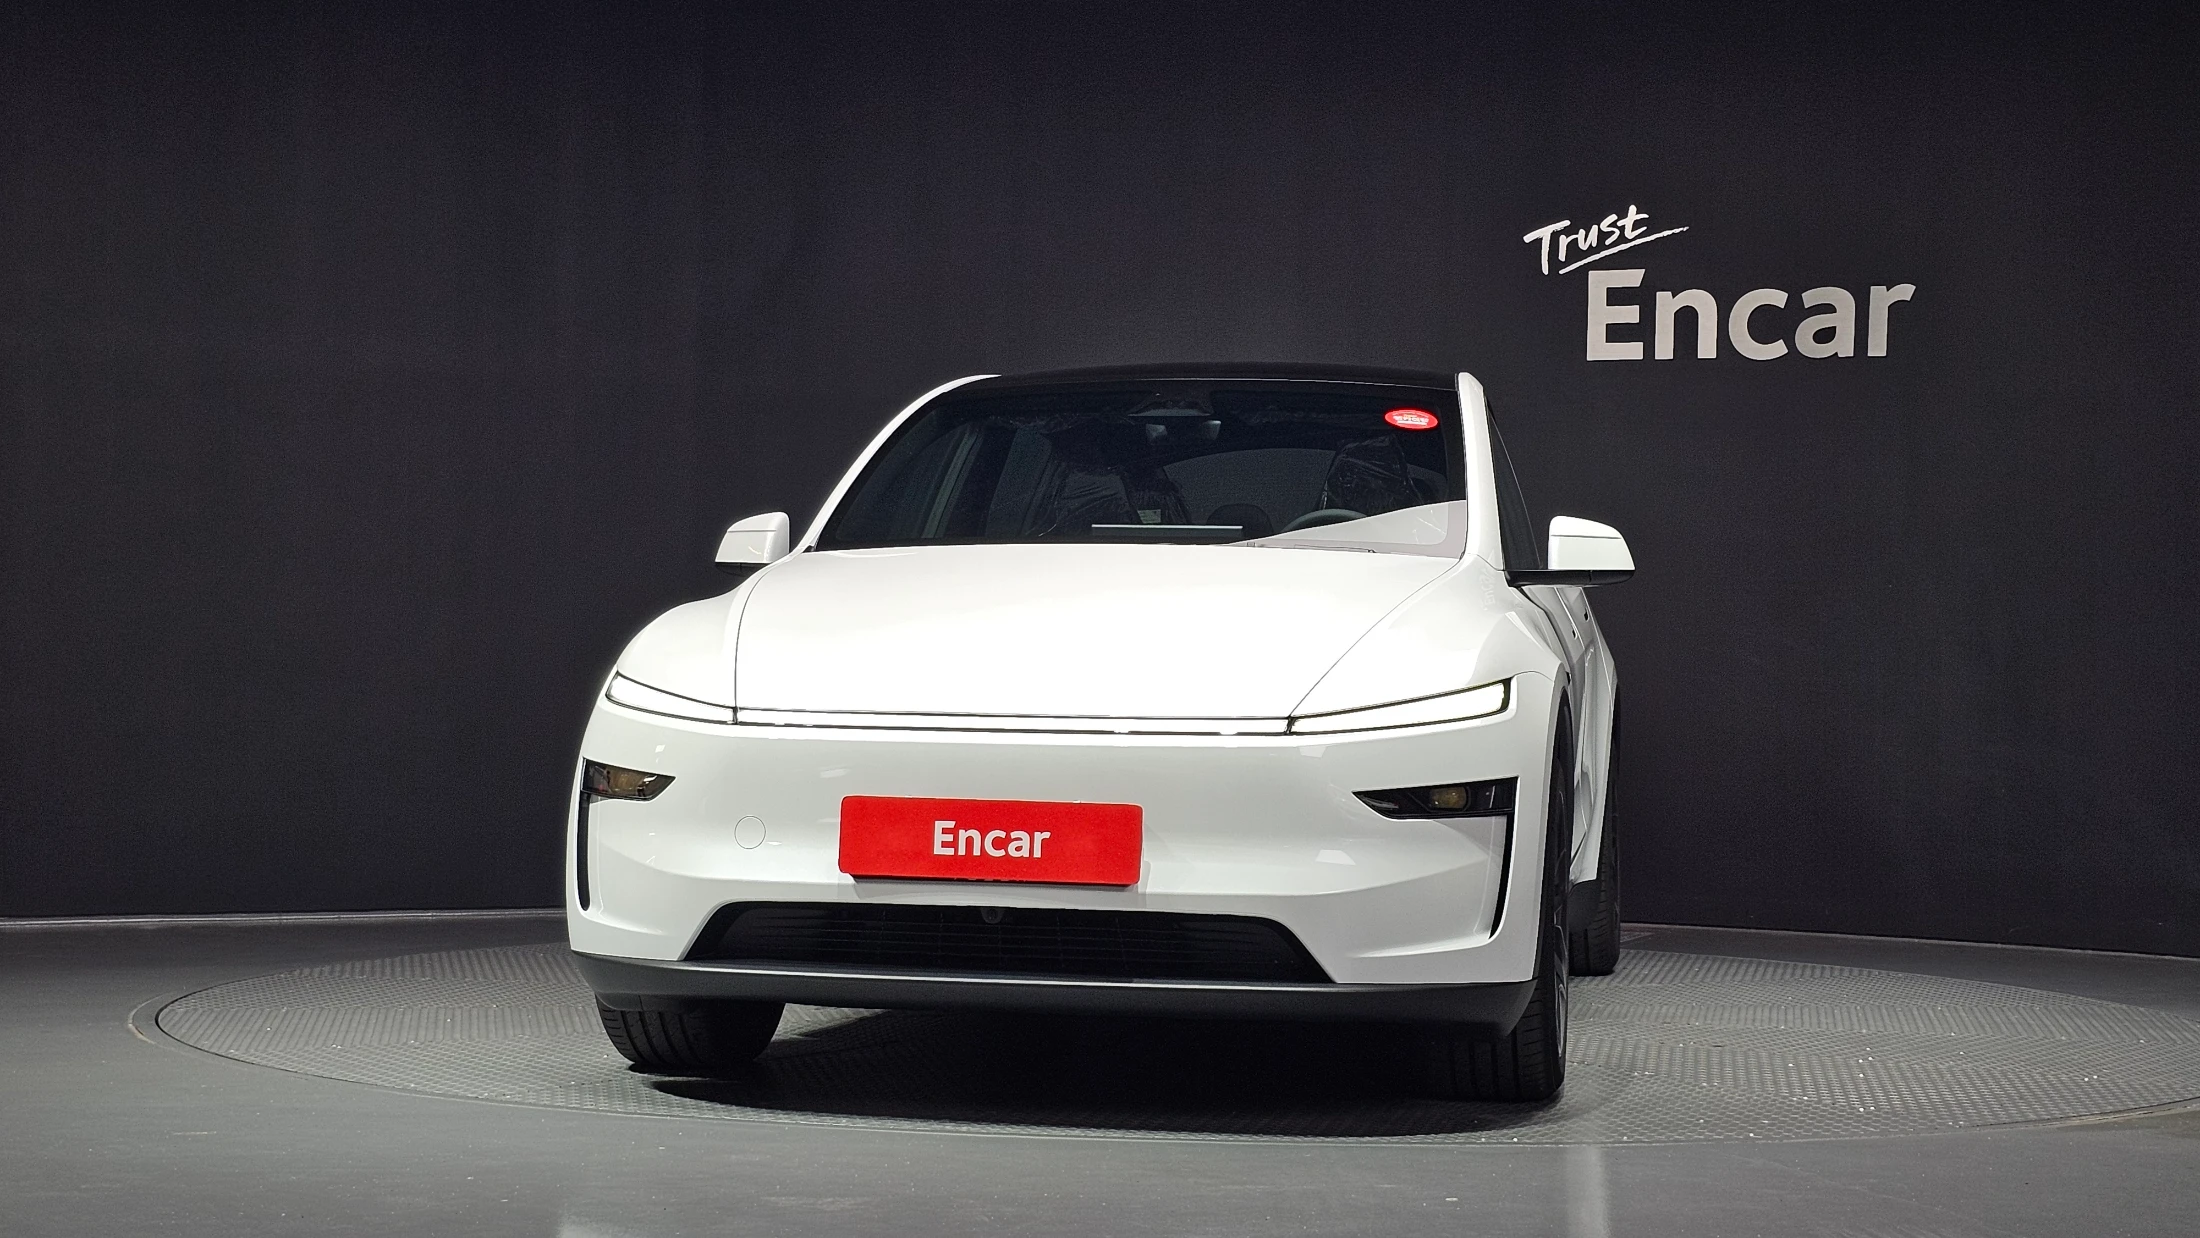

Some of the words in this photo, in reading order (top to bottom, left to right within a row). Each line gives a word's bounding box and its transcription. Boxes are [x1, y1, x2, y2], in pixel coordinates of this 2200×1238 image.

[1523, 205, 1655, 275] Trust
[1586, 268, 1917, 361] Encar
[933, 820, 1051, 858] Encar
